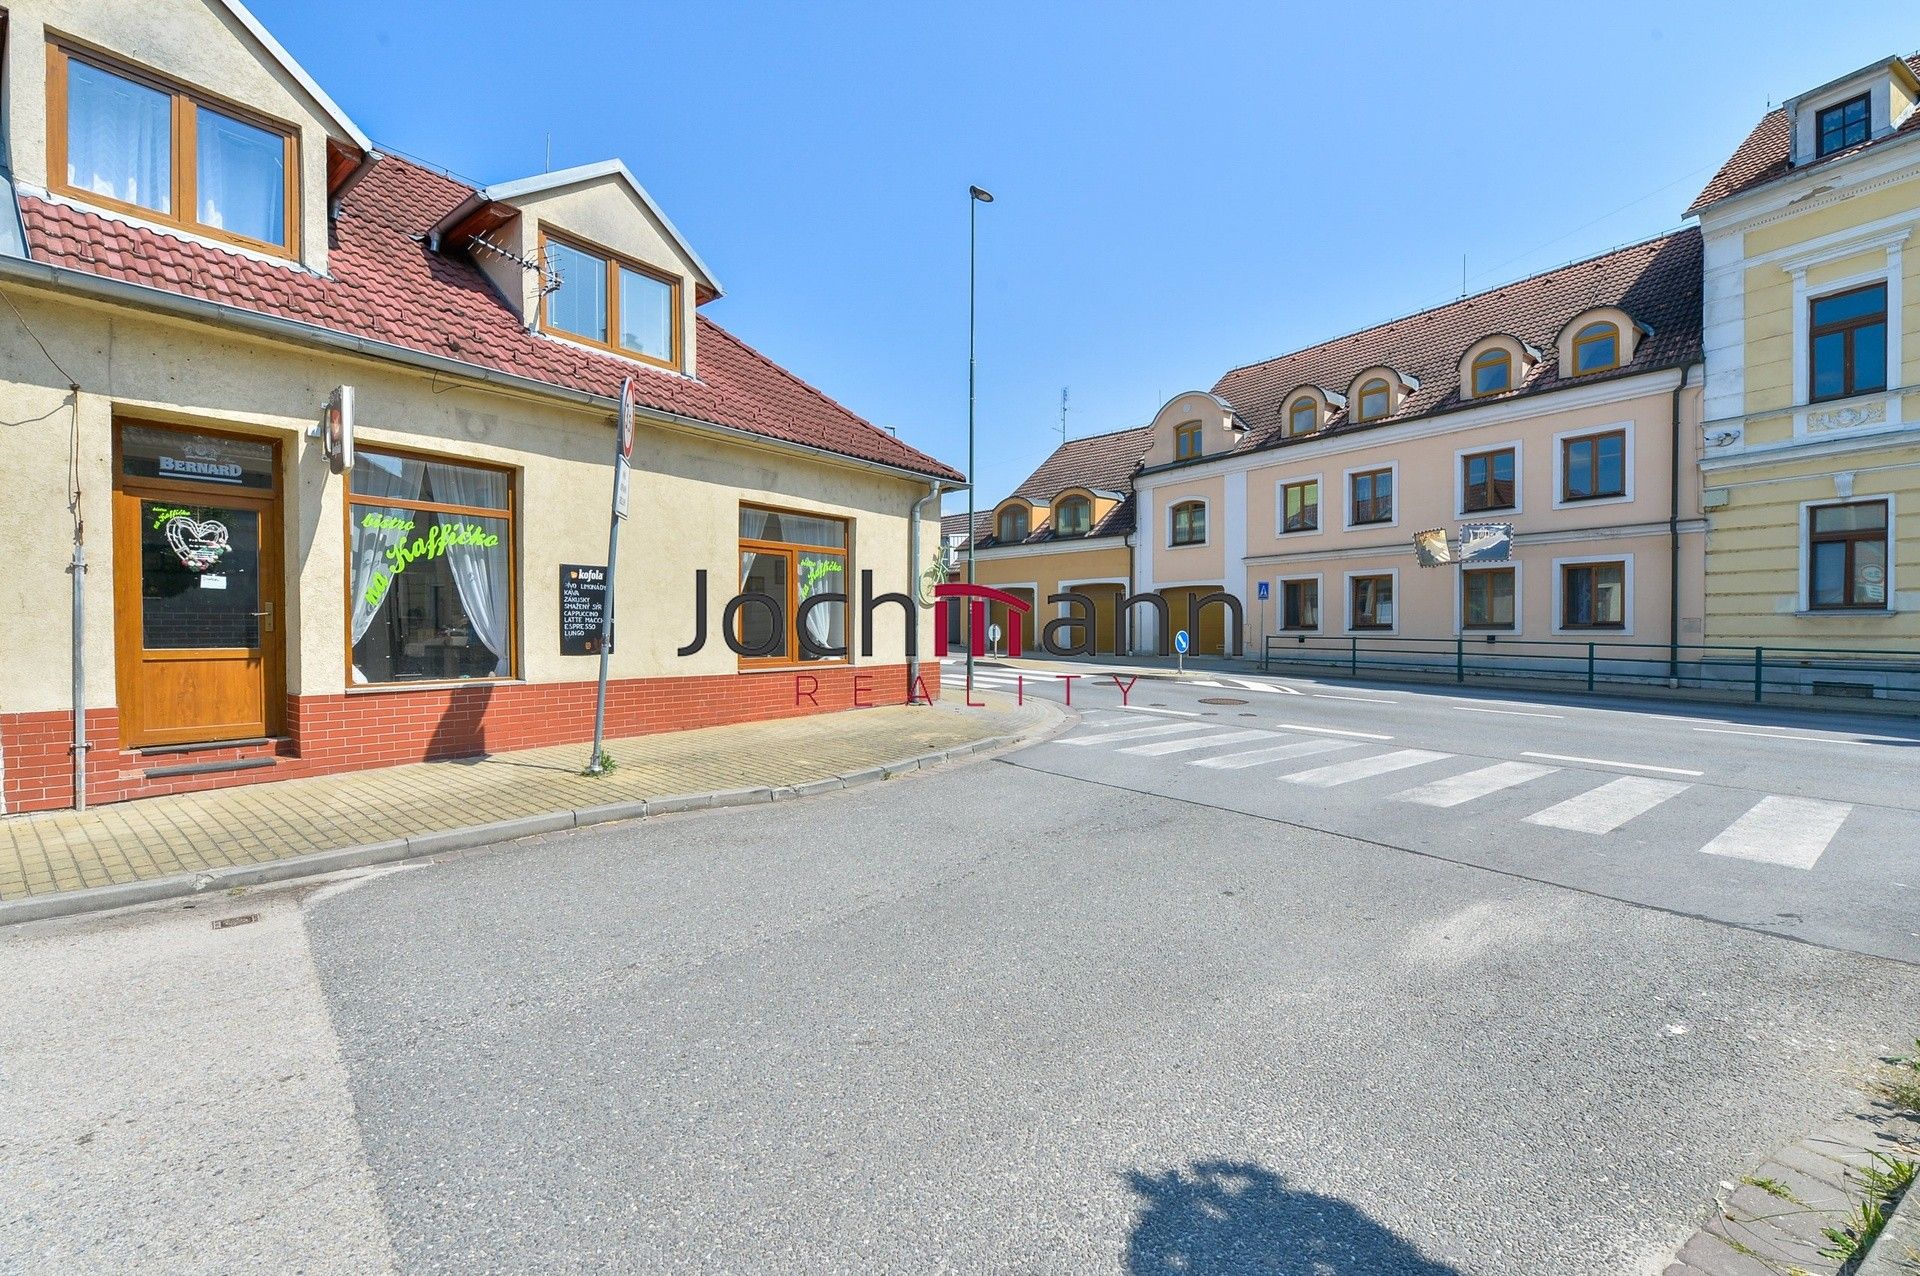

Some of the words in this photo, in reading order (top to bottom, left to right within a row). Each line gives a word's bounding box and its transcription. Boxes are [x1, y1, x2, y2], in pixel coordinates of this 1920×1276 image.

[361, 512, 415, 531] bistro
[578, 568, 603, 582] kofola
[364, 570, 389, 606] na
